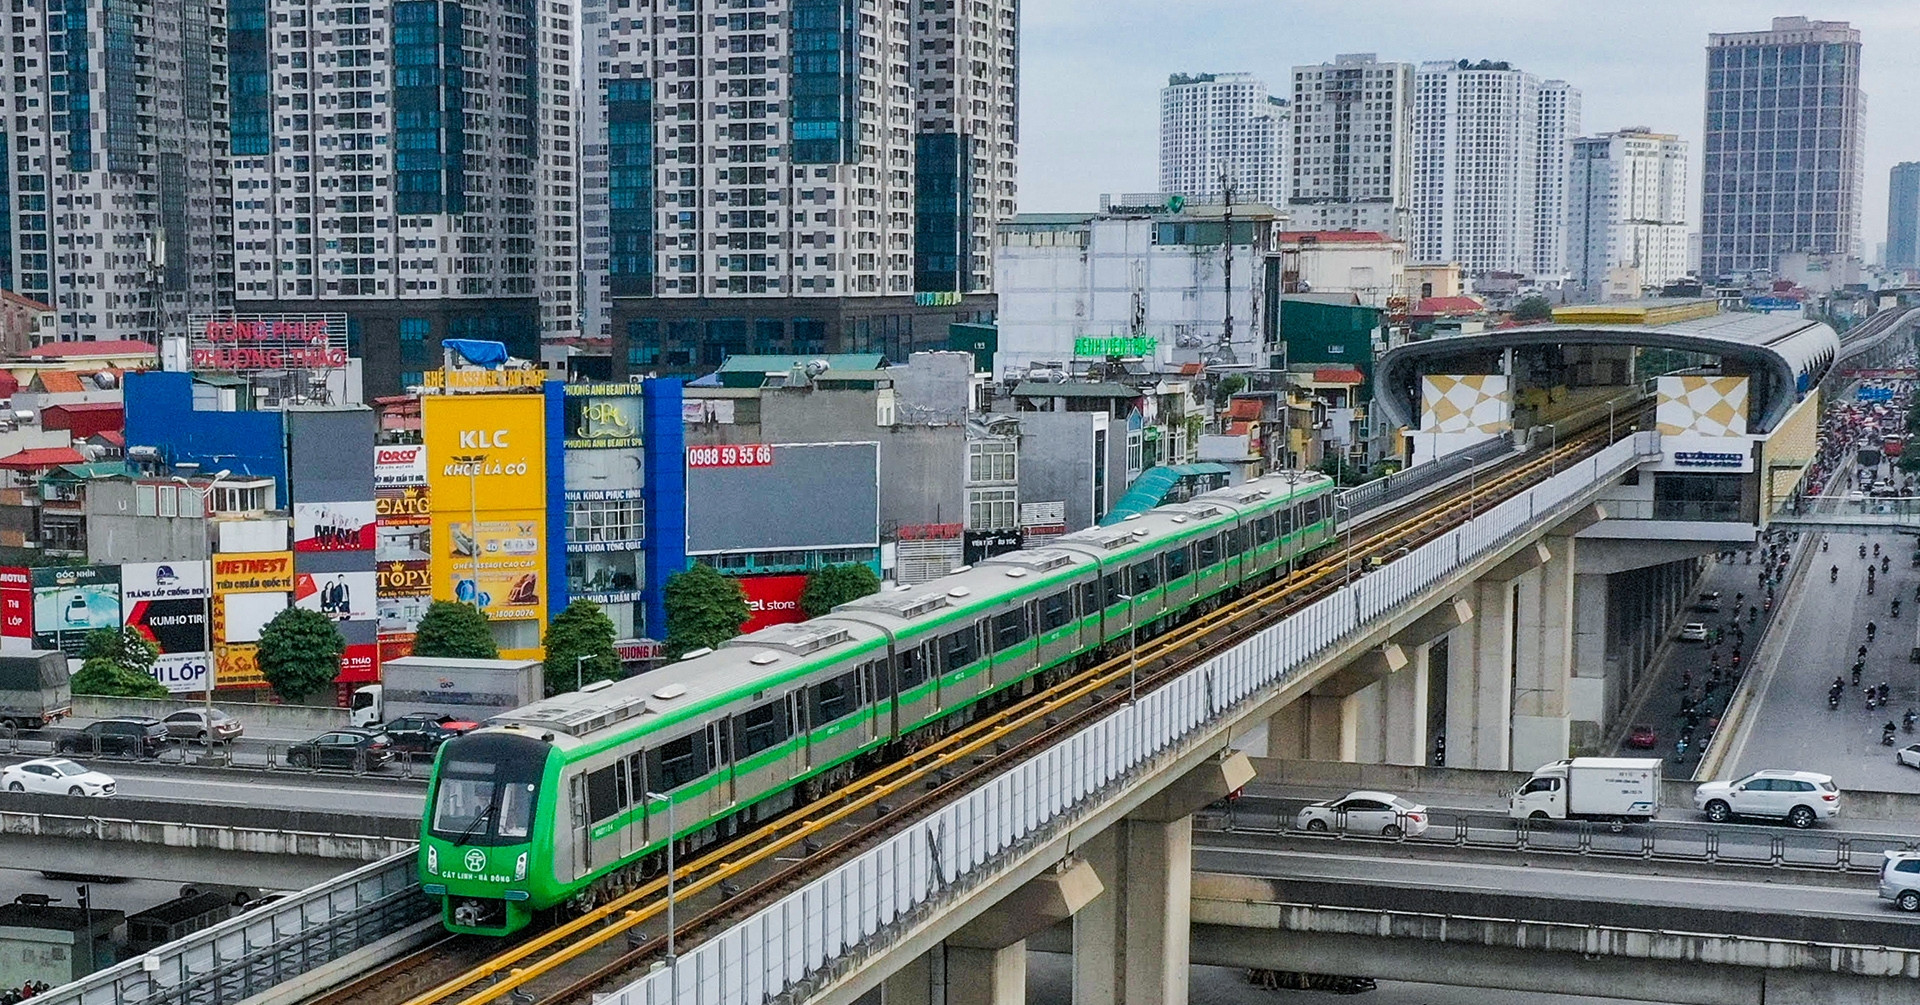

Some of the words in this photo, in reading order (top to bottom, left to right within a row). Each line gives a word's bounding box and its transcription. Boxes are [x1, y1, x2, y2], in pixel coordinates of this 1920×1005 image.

[459, 430, 509, 449] KLC
[689, 448, 719, 465] 0988
[722, 448, 737, 464] 59
[739, 447, 753, 463] 55
[756, 446, 771, 463] 66
[505, 457, 528, 475] CÓ
[565, 491, 581, 500] NHA
[583, 490, 604, 500] KHOA
[392, 497, 430, 514] ATG
[567, 544, 583, 552] NHA
[585, 543, 605, 552] KHOA
[216, 558, 288, 575] VIETNEST
[377, 570, 430, 587] TOPY
[767, 600, 796, 610] store
[149, 614, 187, 626] KUMHO
[457, 872, 473, 880] LINH
